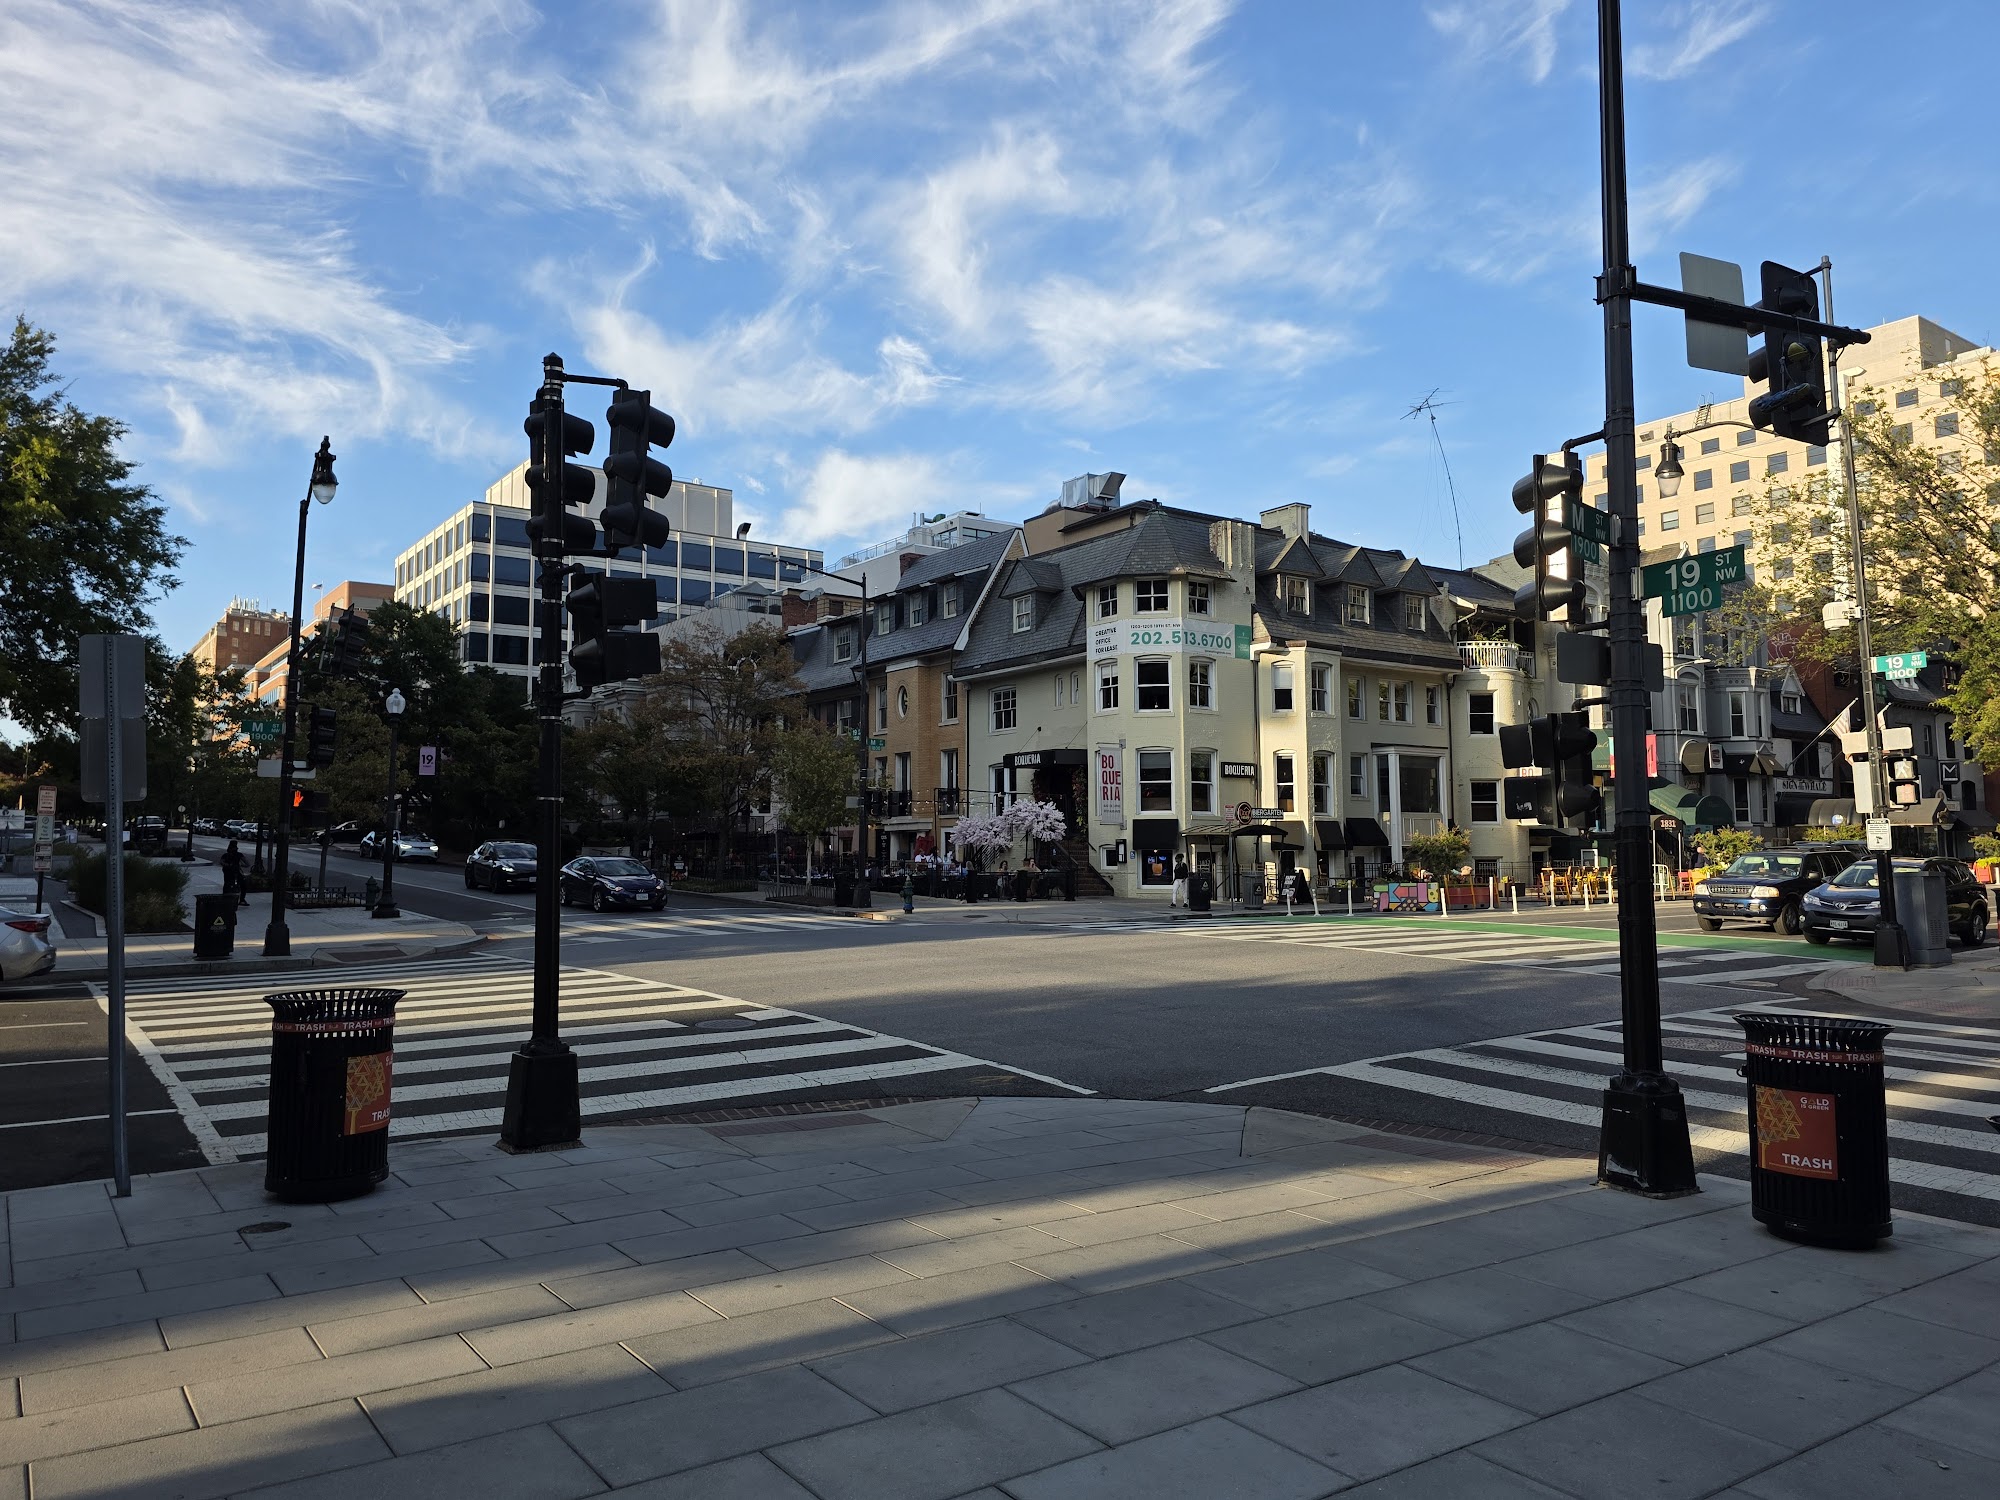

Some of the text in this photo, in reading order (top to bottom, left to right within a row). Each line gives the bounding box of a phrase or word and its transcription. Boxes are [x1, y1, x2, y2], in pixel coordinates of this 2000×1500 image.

[1572, 503, 1604, 533] M ST
[1595, 528, 1607, 541] NW
[1573, 534, 1597, 560] 1900
[1665, 551, 1733, 591] 19 ST
[1715, 566, 1738, 582] NW
[1670, 587, 1713, 613] 1100
[1095, 627, 1117, 637] CREATIVE
[1095, 637, 1111, 645] OFFICE
[1130, 631, 1232, 650] 202.513.6700
[1885, 656, 1904, 669] 19
[1887, 667, 1915, 679] 1100
[252, 722, 264, 733] M
[251, 732, 274, 741] 1900
[1014, 753, 1042, 767] BOQUERIA
[1102, 754, 1115, 769] BO
[1224, 764, 1255, 776] BOQUERIA
[1102, 770, 1122, 786] QUE
[1782, 780, 1798, 790] SIGN
[1804, 780, 1827, 792] WHALE
[1103, 785, 1121, 801] RIA
[1252, 808, 1284, 816] BIERGARTEN
[1660, 819, 1677, 828] 1831
[295, 1023, 326, 1031] TRASH
[343, 1020, 373, 1030] TRASH
[1751, 1044, 1776, 1056] TRASH
[1791, 1049, 1829, 1061] TRASH
[1846, 1053, 1875, 1062] TRASH
[1781, 1153, 1832, 1170] TRASH
